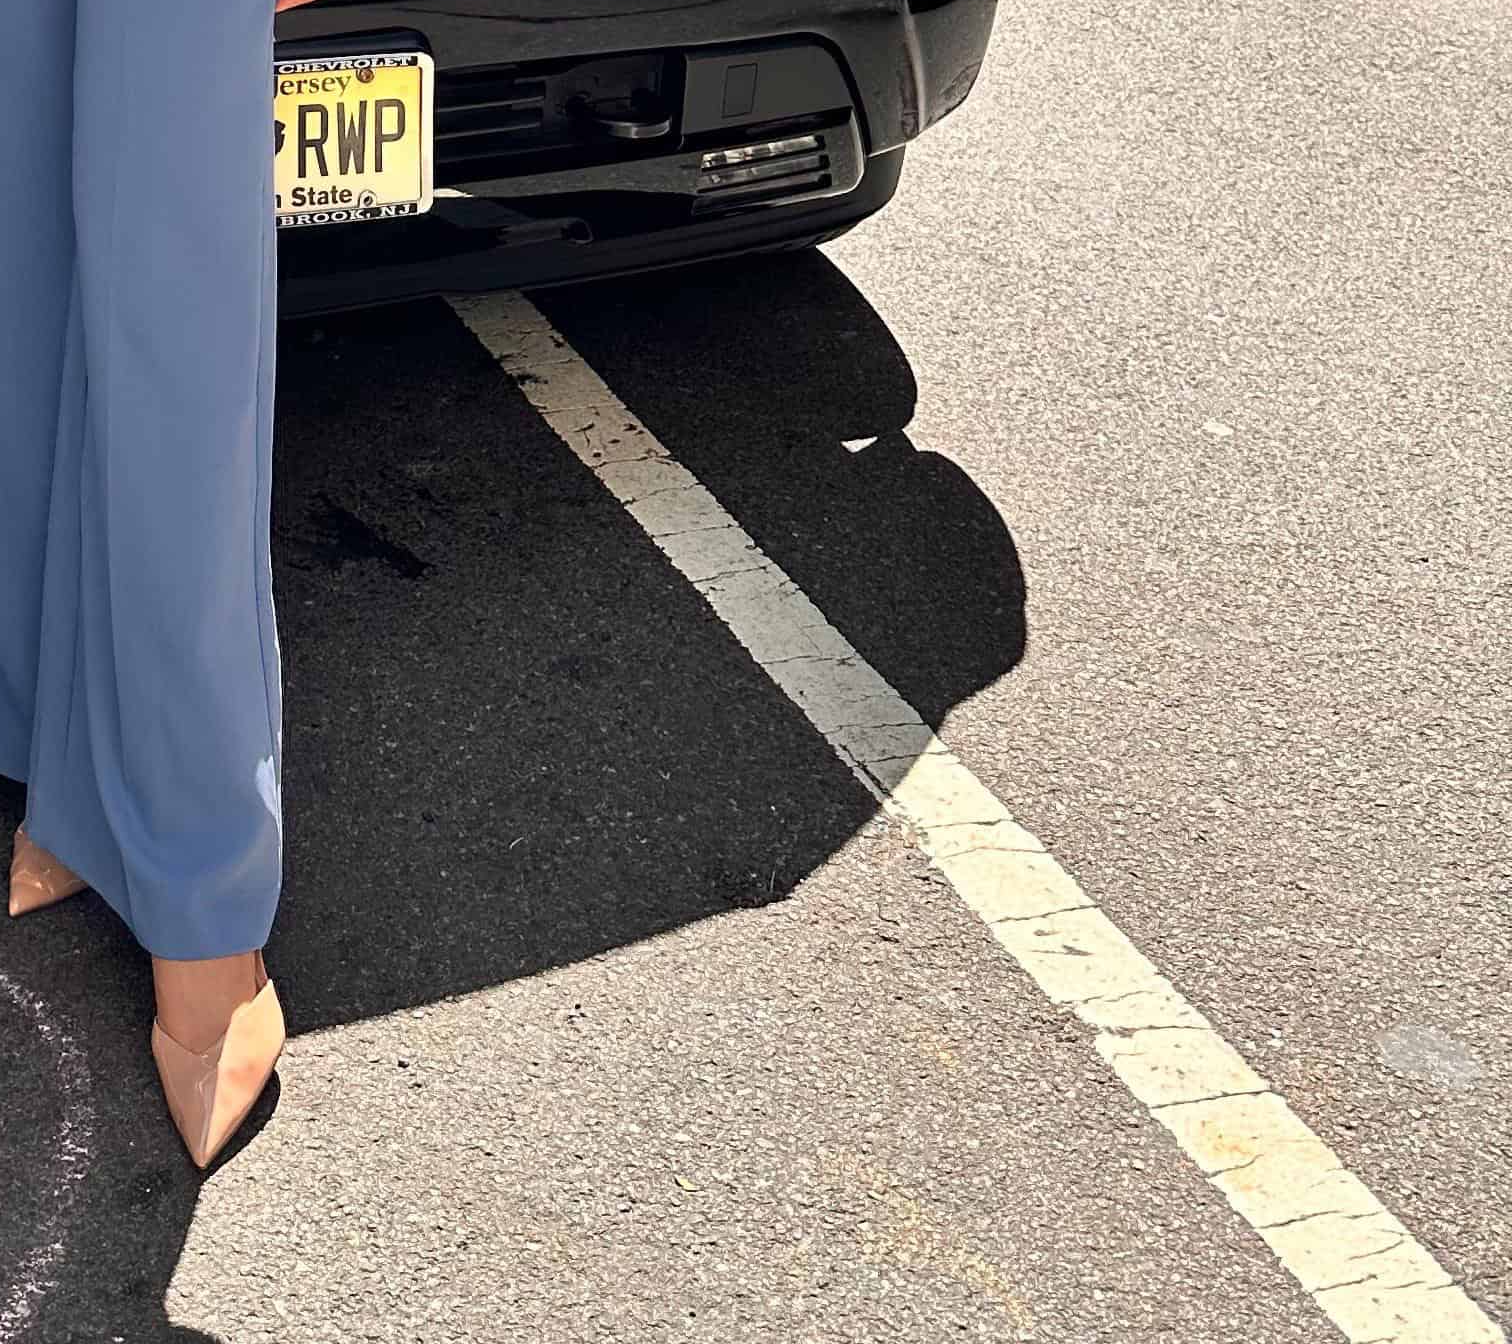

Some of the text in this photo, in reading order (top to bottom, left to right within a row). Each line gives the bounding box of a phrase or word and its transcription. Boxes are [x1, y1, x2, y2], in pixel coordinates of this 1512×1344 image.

[278, 56, 412, 74] CHEVROLET
[297, 98, 406, 179] RWP
[291, 184, 353, 207] State
[280, 204, 410, 226] BROOK, NJ
